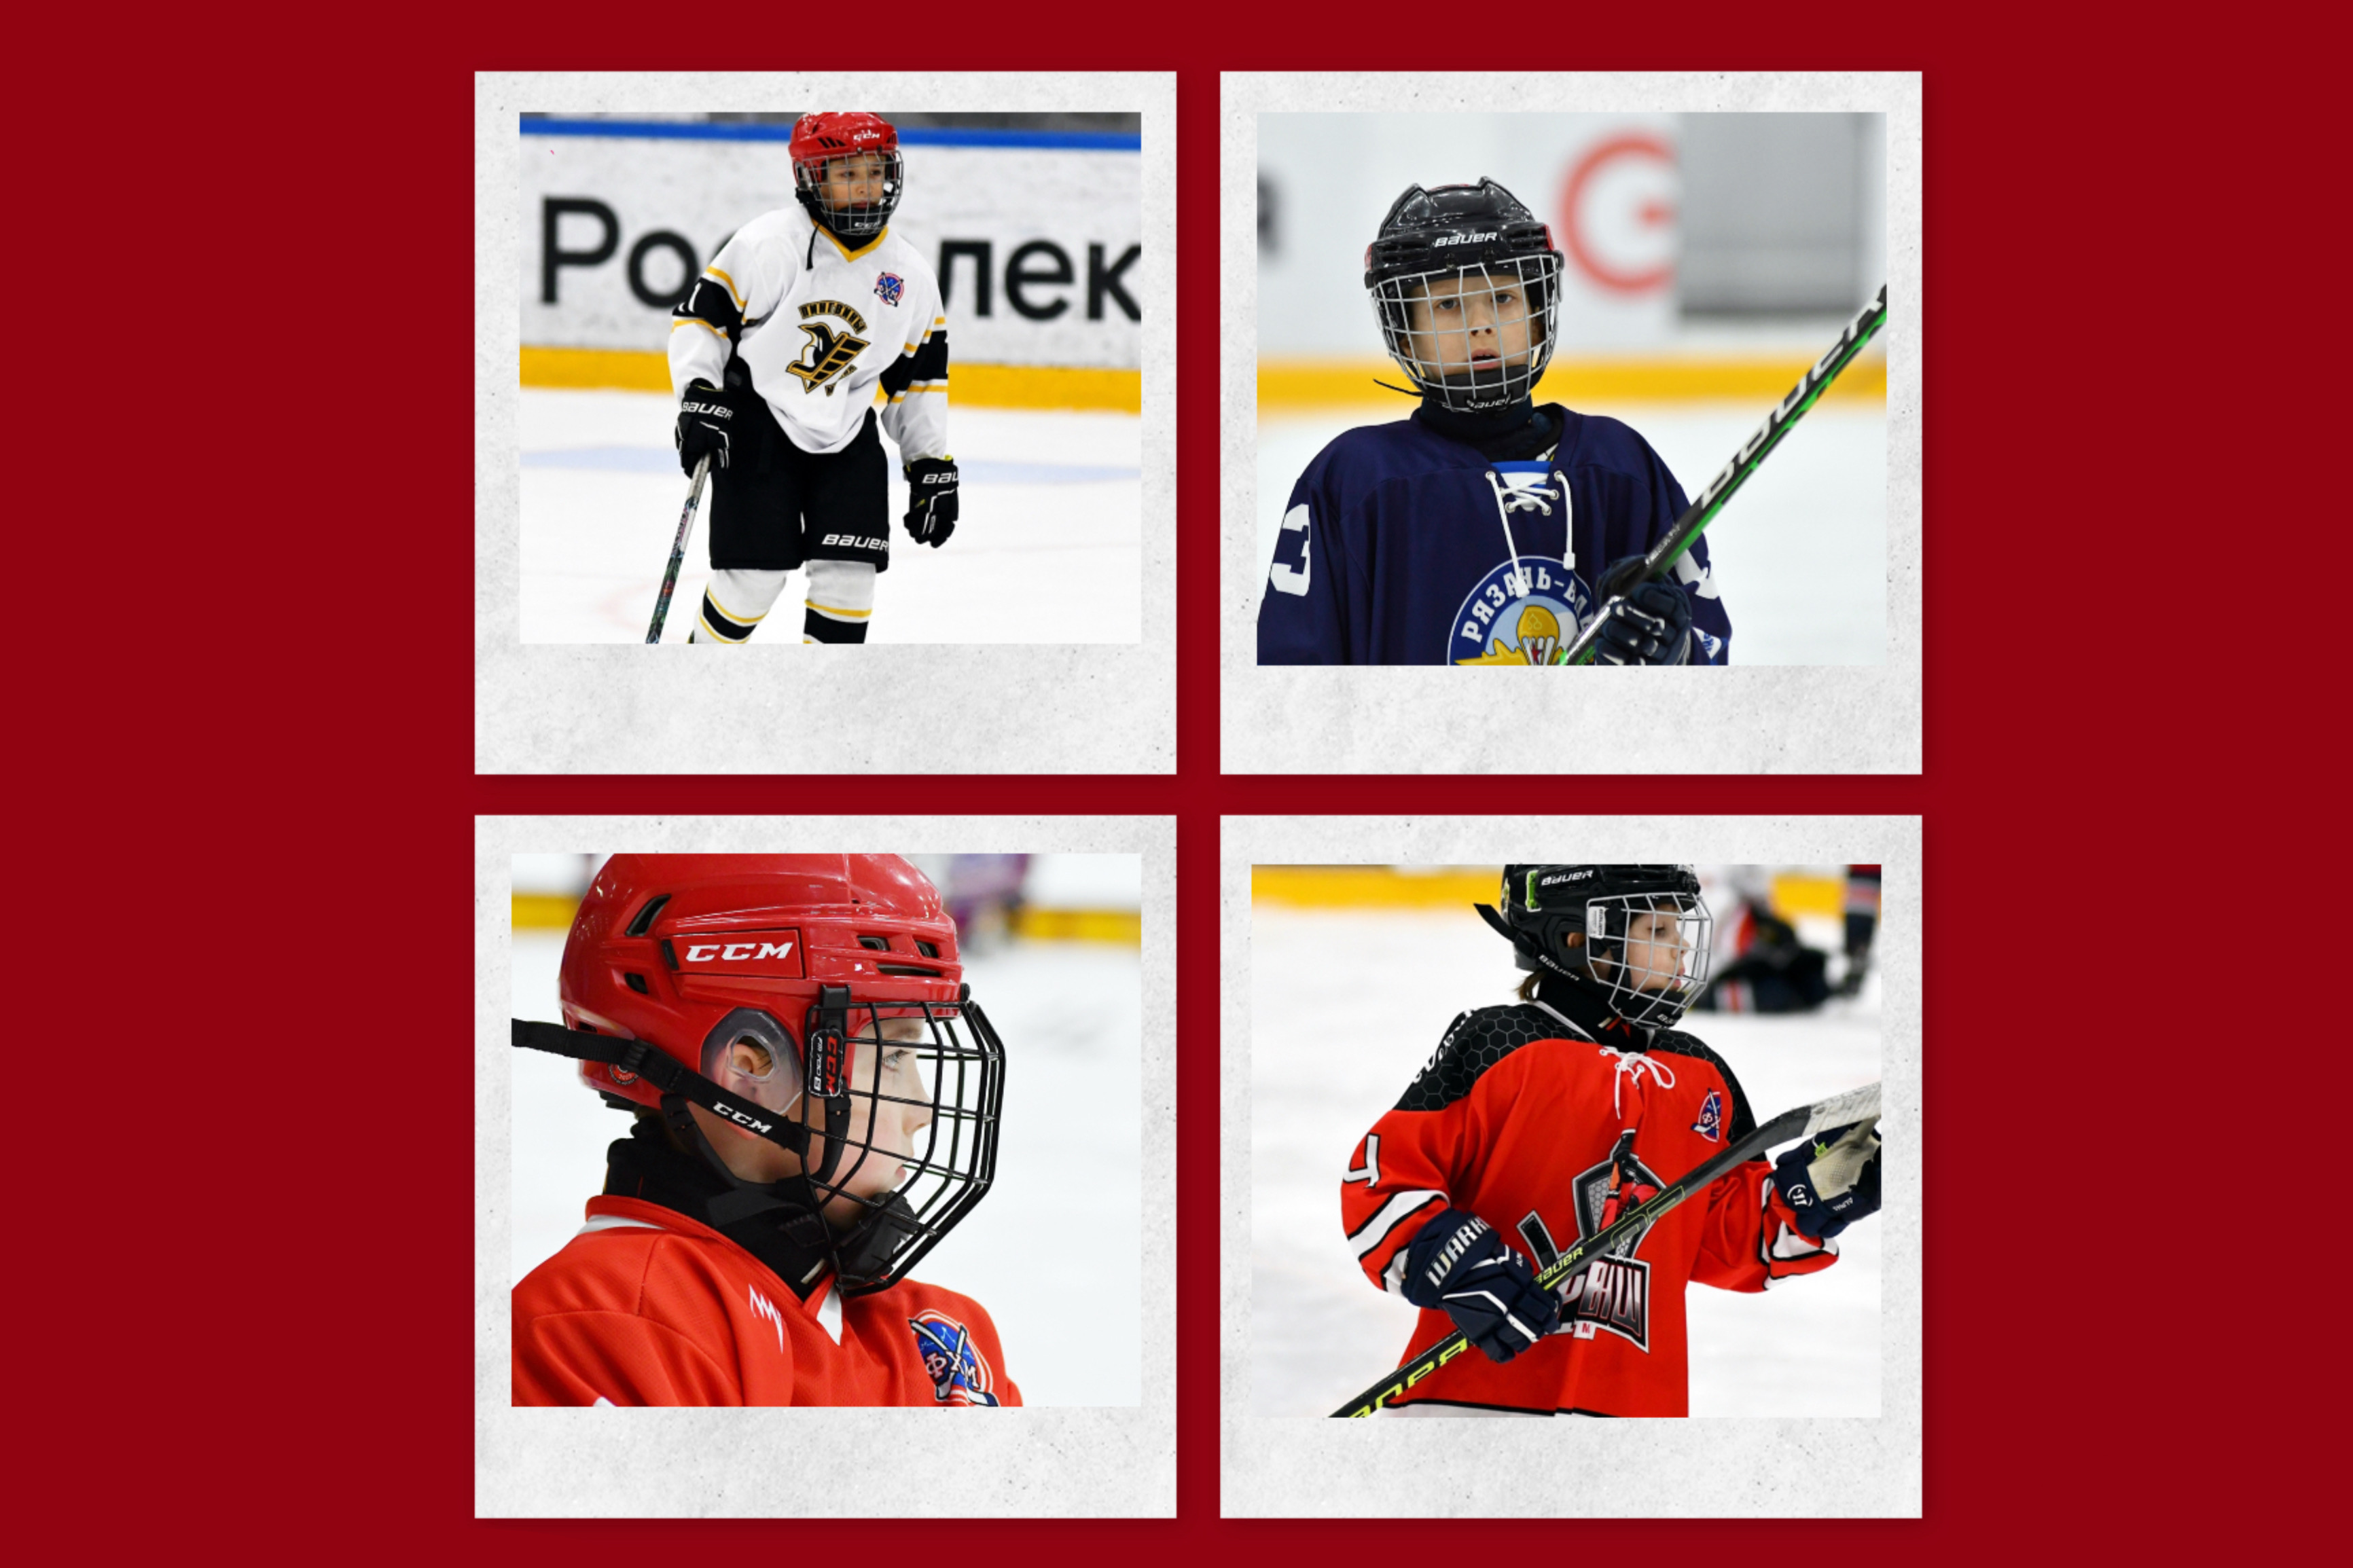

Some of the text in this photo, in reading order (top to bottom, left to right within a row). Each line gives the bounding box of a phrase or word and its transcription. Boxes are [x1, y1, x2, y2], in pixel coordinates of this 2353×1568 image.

[1434, 232, 1498, 247] BAUER
[682, 401, 734, 421] BAUER
[821, 534, 888, 552] BAUER
[1541, 870, 1594, 886] BAUER
[685, 942, 793, 962] CCM
[1539, 954, 1580, 981] BAUER
[826, 1036, 838, 1094] CCM
[713, 1101, 772, 1134] CCM
